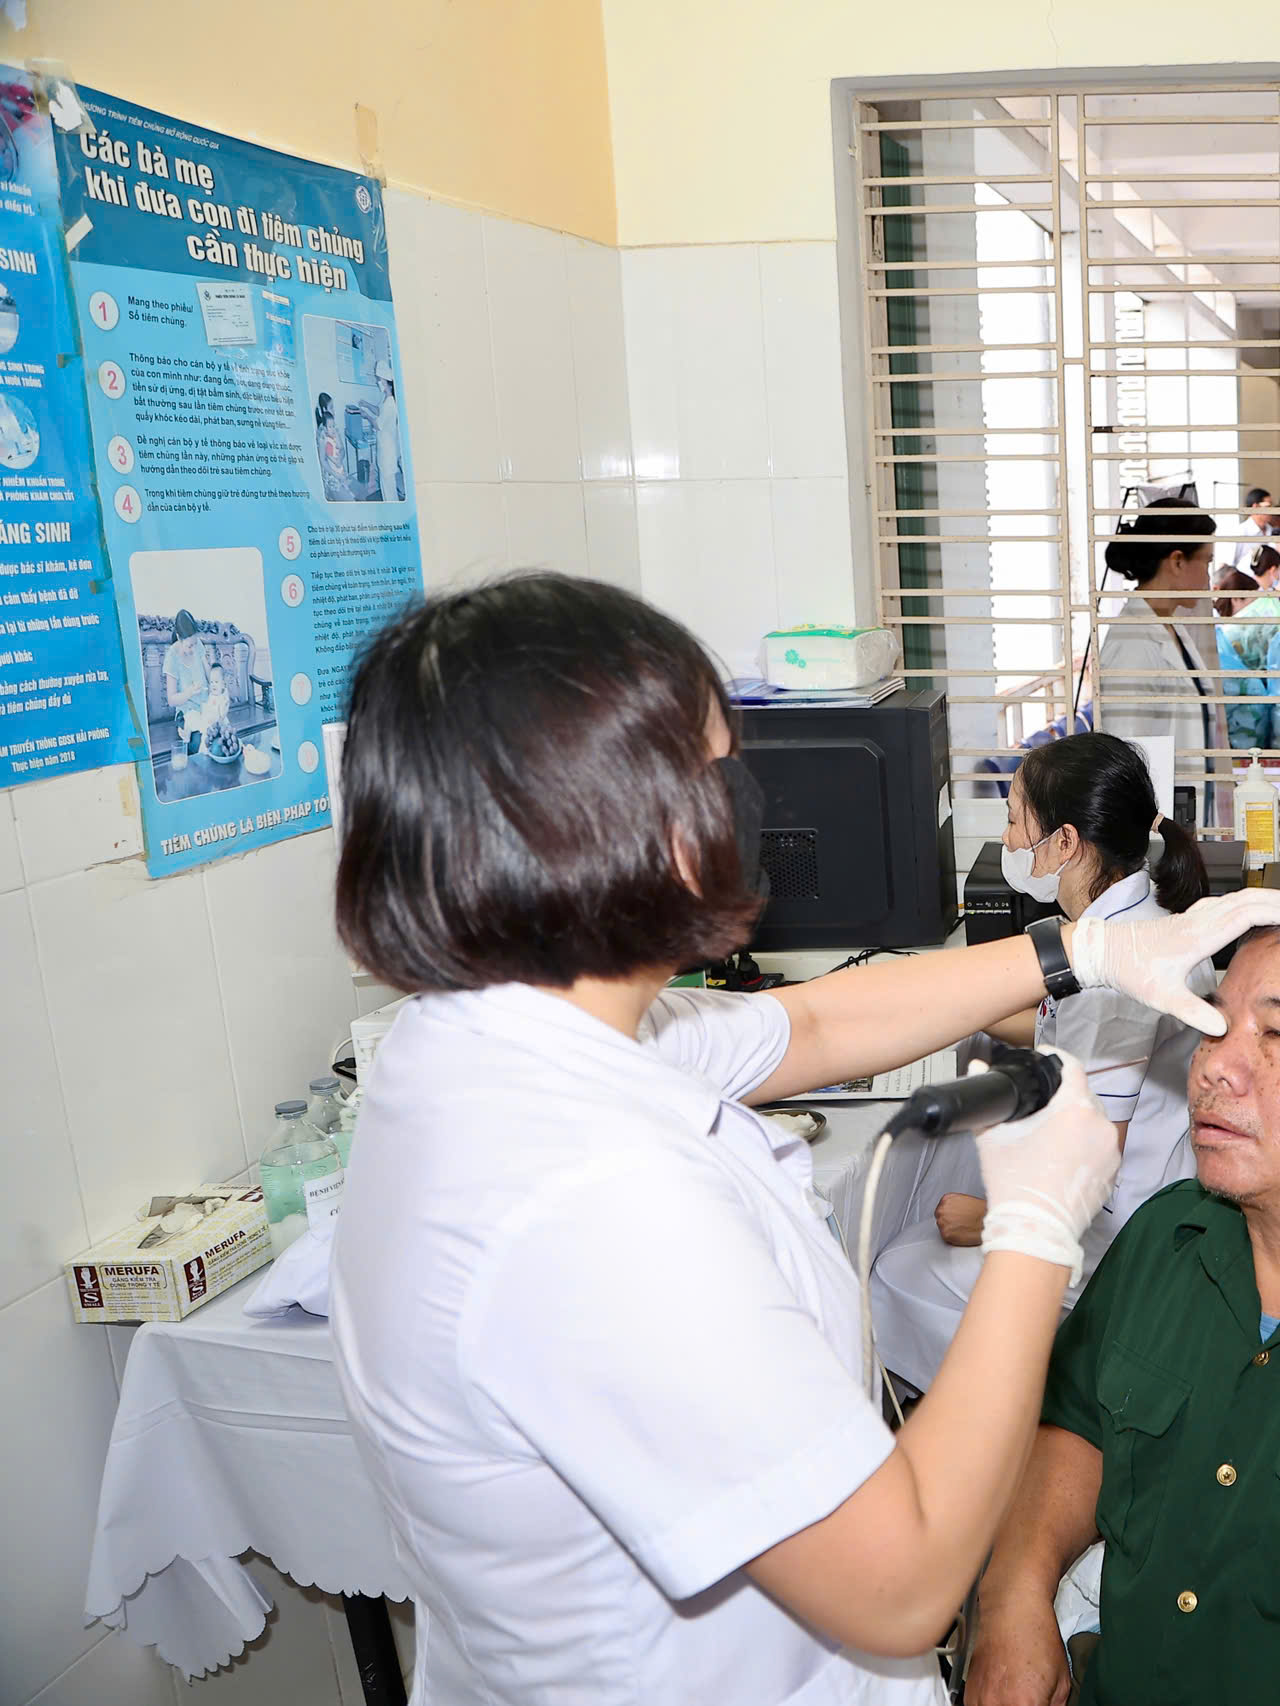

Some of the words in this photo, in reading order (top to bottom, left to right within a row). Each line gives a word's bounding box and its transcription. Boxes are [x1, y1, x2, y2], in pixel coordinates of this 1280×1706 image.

[80, 130, 131, 168] Các
[136, 140, 169, 179] bà
[175, 157, 215, 195] mẹ
[84, 166, 130, 207] khi
[134, 181, 183, 220] đưa
[187, 198, 234, 231] con
[236, 205, 258, 236] đi
[261, 213, 302, 248] tiêm
[306, 225, 364, 264] chủng
[0, 247, 37, 275] SINH
[186, 229, 240, 267] cần
[243, 243, 292, 282] thực
[297, 255, 348, 292] hiện
[99, 301, 108, 321] 1
[128, 296, 150, 309] Mang
[152, 299, 169, 310] theo
[174, 358, 188, 367] cho
[107, 370, 118, 390] 2
[179, 401, 192, 409] sau
[117, 445, 126, 465] 3
[181, 466, 196, 474] theo
[221, 467, 233, 475] sau
[145, 488, 164, 499] Trong
[166, 489, 176, 497] khi
[122, 494, 133, 514] 4
[35, 522, 71, 543] SINH
[287, 536, 295, 553] 5
[289, 583, 298, 600] 6
[161, 834, 192, 856] TIÊM
[194, 821, 237, 847] CHỦNG
[240, 816, 254, 835] LÀ
[256, 809, 282, 830] BIỆN
[284, 802, 312, 822] PHÁP
[204, 1230, 246, 1258] MERUFA
[104, 1266, 159, 1276] MERUFA
[83, 1292, 99, 1303] S
